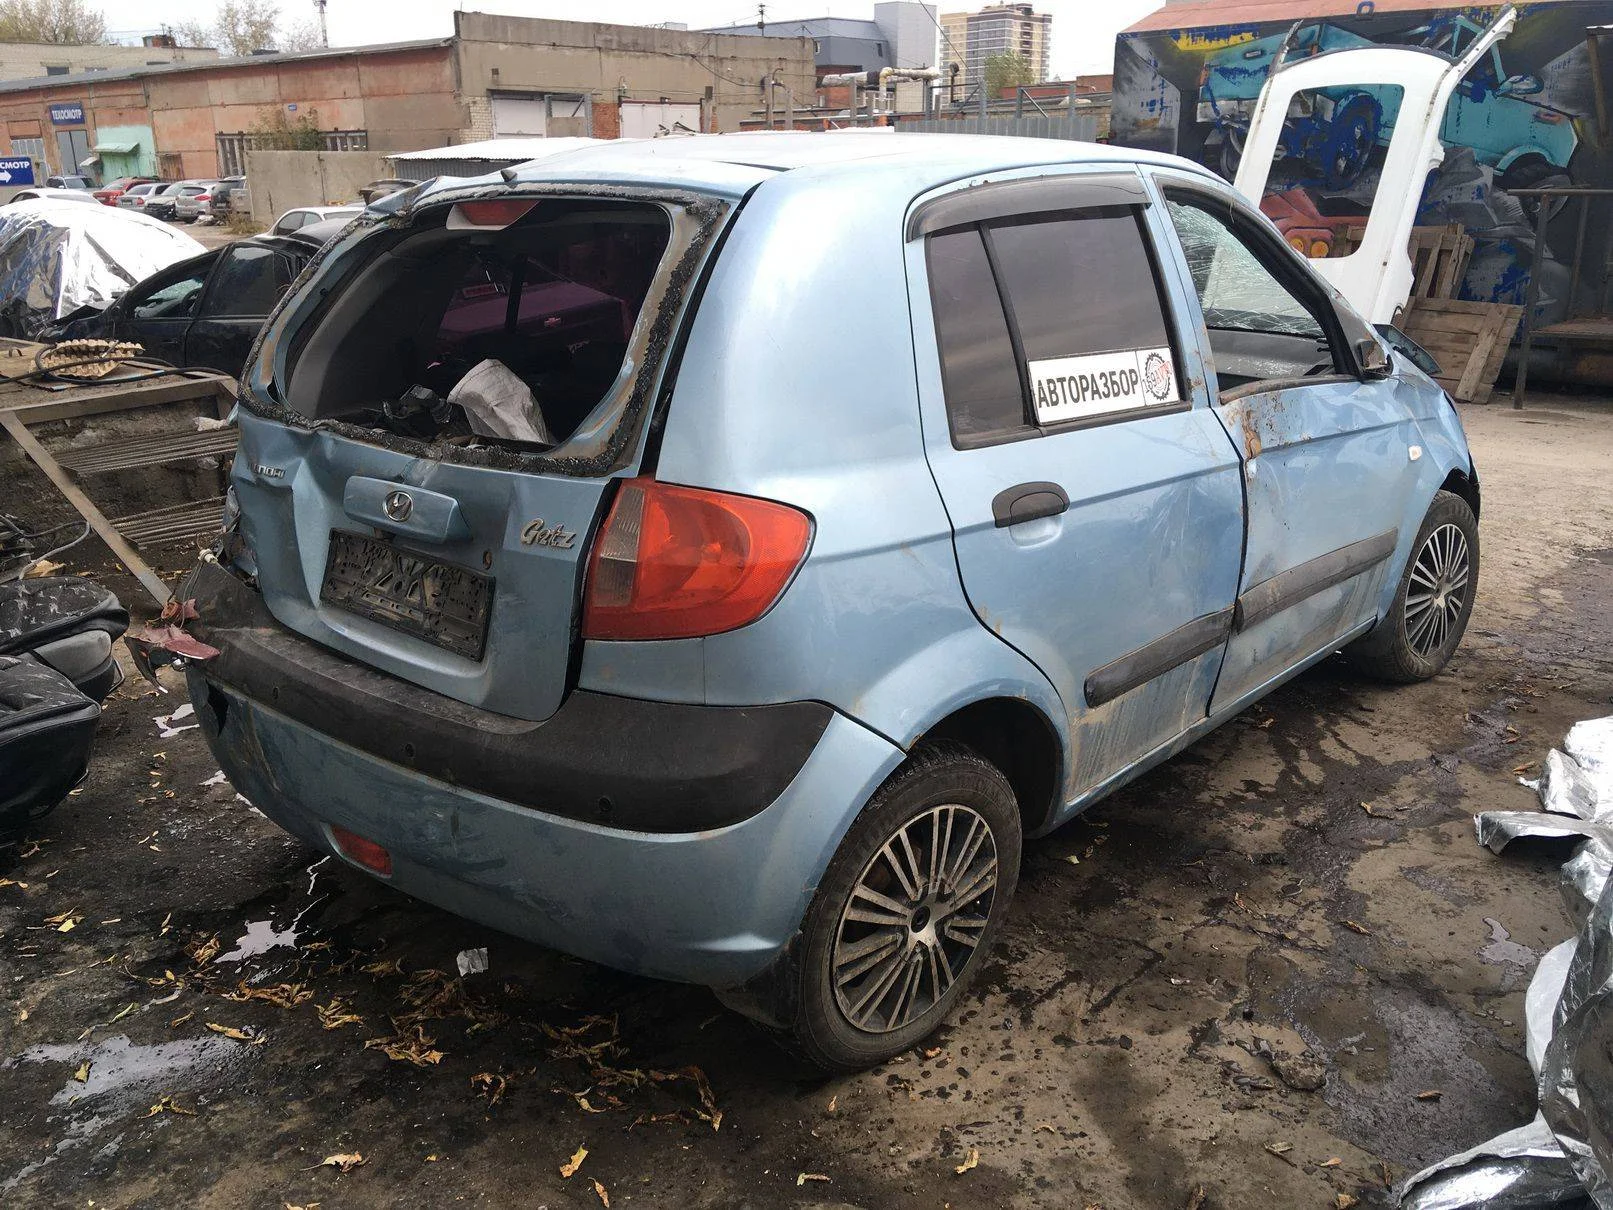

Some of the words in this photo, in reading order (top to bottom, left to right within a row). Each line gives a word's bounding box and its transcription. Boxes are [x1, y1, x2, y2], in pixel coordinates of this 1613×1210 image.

[51, 109, 82, 120] ТЕХОСМОТР
[1037, 368, 1139, 408] АВТОРАЗБОР
[520, 518, 577, 549] Getz
